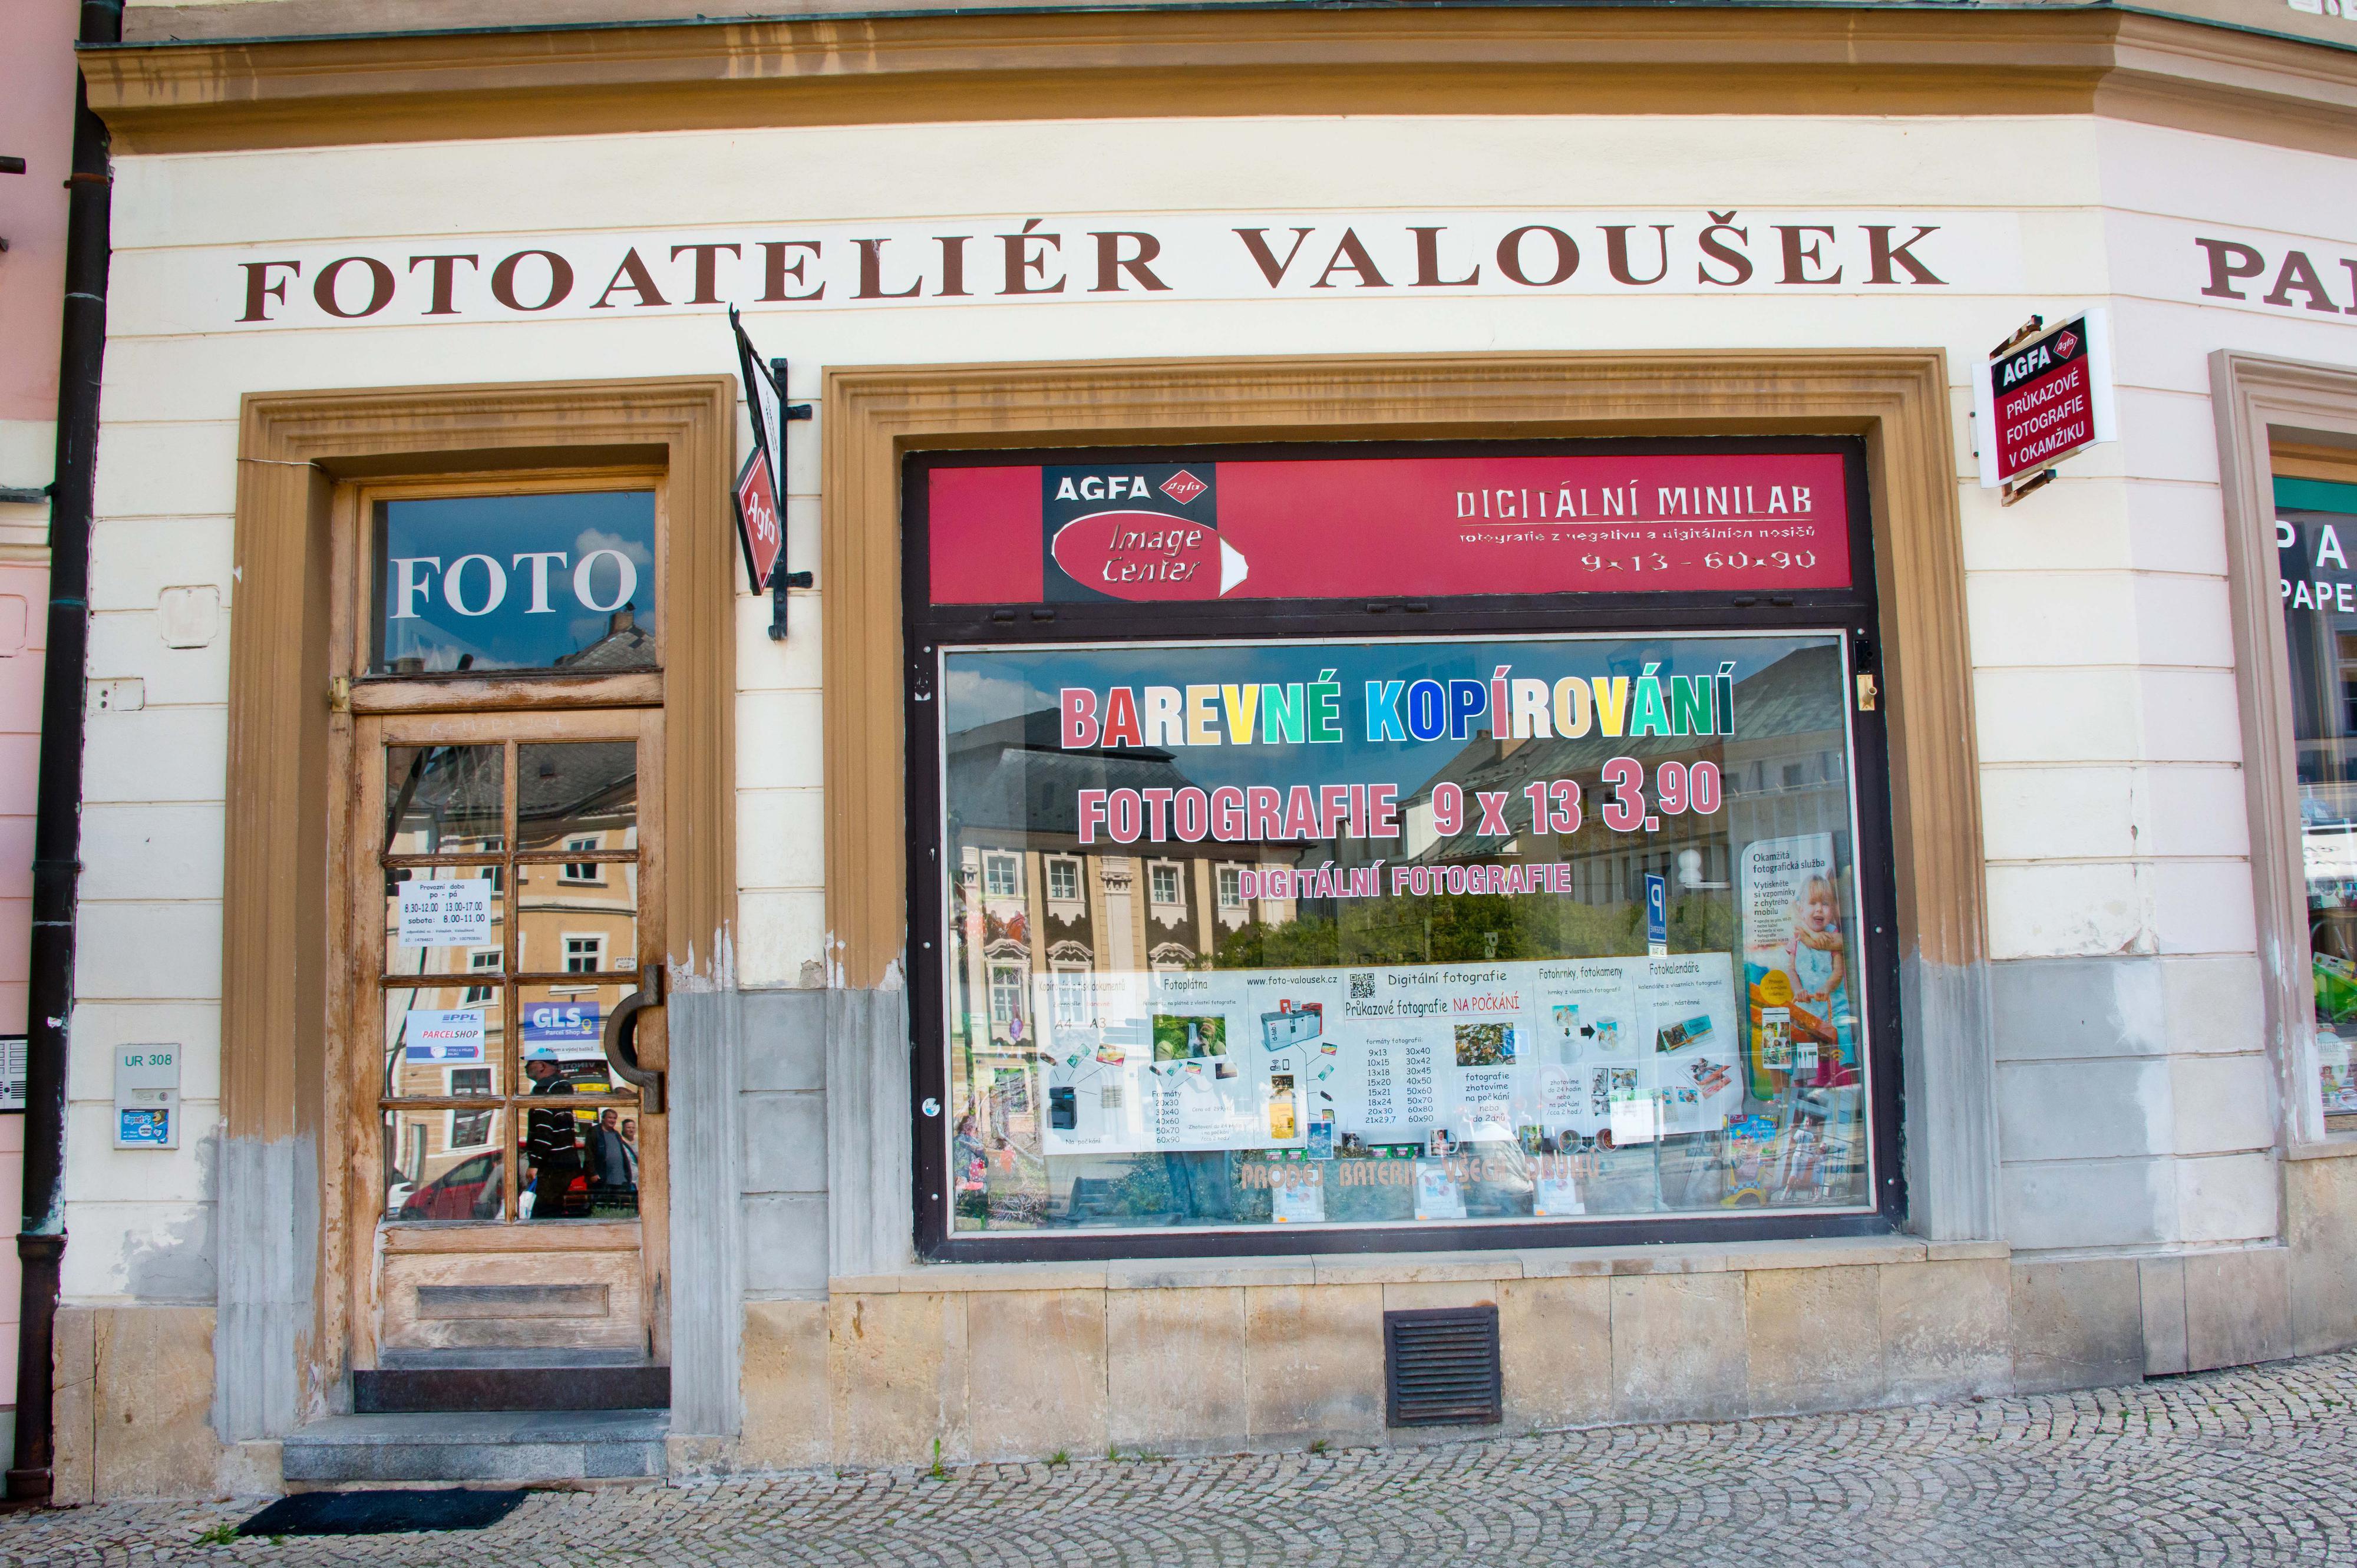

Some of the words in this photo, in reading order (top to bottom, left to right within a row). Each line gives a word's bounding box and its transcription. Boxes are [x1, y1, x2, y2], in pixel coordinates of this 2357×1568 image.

[235, 219, 1173, 322] FOTOATELIÉR
[1232, 211, 1949, 289] VALOUŠEK
[2003, 345, 2051, 387] AGFA
[2057, 337, 2074, 352] Agfa
[2006, 368, 2079, 420] PRŮKAZOVÉ
[2006, 395, 2084, 444] FOTOGRAFIE
[2008, 453, 2017, 467] V
[2020, 421, 2085, 463] OKAMŽIKU
[1054, 476, 1153, 501] AGFA
[1166, 481, 1201, 494] Agfa
[1455, 479, 1640, 519] DIGITÁLNÍ
[1658, 485, 1812, 516] MINILAB
[747, 491, 775, 546] Agfa
[1108, 523, 1203, 557] Image
[1551, 533, 1560, 542] z
[1758, 526, 1815, 539] nosičů
[1580, 552, 1669, 572] 9x13
[1704, 550, 1816, 569] 60x90
[1102, 556, 1201, 583] Center
[389, 549, 638, 619] FOTO
[2279, 579, 2357, 612] PAPE
[1060, 668, 1343, 749] BAREVNÉ
[1365, 661, 1737, 742] KOPÍROVÁNÍ
[1078, 783, 1399, 844] FOTOGRAFIE
[1431, 781, 1463, 837] 9
[1475, 791, 1511, 836] x
[1524, 779, 1582, 835] 13
[1753, 850, 1790, 863] Okamžitá
[1753, 860, 1799, 874] fotografická
[1801, 859, 1825, 869] služba
[1239, 859, 1386, 900] DIGITÁLNÍ
[1392, 863, 1572, 896] FOTOGRAFIE
[1754, 880, 1789, 890] Vytiskněte
[449, 890, 458, 899] pá
[1762, 888, 1795, 899] vzpomínky
[405, 903, 439, 913] 8.30-12.00
[445, 902, 483, 912] 13.00-17.00
[1760, 897, 1788, 907] chytrého
[1754, 907, 1778, 916] mobilu
[443, 914, 486, 923] 8.00-11.00
[1539, 967, 1579, 981] Fotohrnky,
[1580, 966, 1623, 979] fotokameny
[1649, 960, 1699, 976] Fotokalendáře
[1164, 978, 1208, 993] Fotoplátna
[1247, 975, 1338, 985] www.foto-valousek.cz
[1388, 972, 1438, 988] Digitální
[1443, 970, 1507, 985] fotografie
[1346, 1000, 1395, 1016] Průkazové
[1397, 998, 1448, 1017] fotografie
[1453, 998, 1469, 1012] NA
[1472, 991, 1520, 1011] POČKÁNÍ
[533, 1008, 582, 1028] GLS
[1054, 1018, 1073, 1030] A4
[1090, 1017, 1107, 1029] A3
[422, 1030, 478, 1038] PARCELSHOP
[1270, 1022, 1278, 1041] d-lab.1
[1392, 1036, 1424, 1045] fotografií:
[1405, 1047, 1431, 1055] 30x40
[125, 1055, 143, 1067] UR
[148, 1054, 172, 1065] 308
[1367, 1058, 1389, 1067] 10x15
[1368, 1068, 1390, 1077] 13x18
[1465, 1071, 1510, 1082] fotografie
[1406, 1077, 1432, 1085] 40x50
[1465, 1082, 1508, 1092] zhotovíme
[1152, 1090, 1181, 1098] Formáty
[1407, 1087, 1432, 1095] 50x60
[1478, 1091, 1510, 1103] počkání
[1368, 1098, 1391, 1106] 18x24
[1480, 1104, 1499, 1112] nebo
[1557, 1100, 1579, 1109] počkání
[1365, 1115, 1396, 1124] 21x29,7
[1408, 1114, 1434, 1123] 60x90
[1473, 1114, 1483, 1122] do
[1078, 1137, 1101, 1146] počkání
[1241, 1163, 1324, 1189] PRODEJ
[1339, 1154, 1419, 1187] BATERIÍ
[1443, 1151, 1507, 1184] VŠECH
